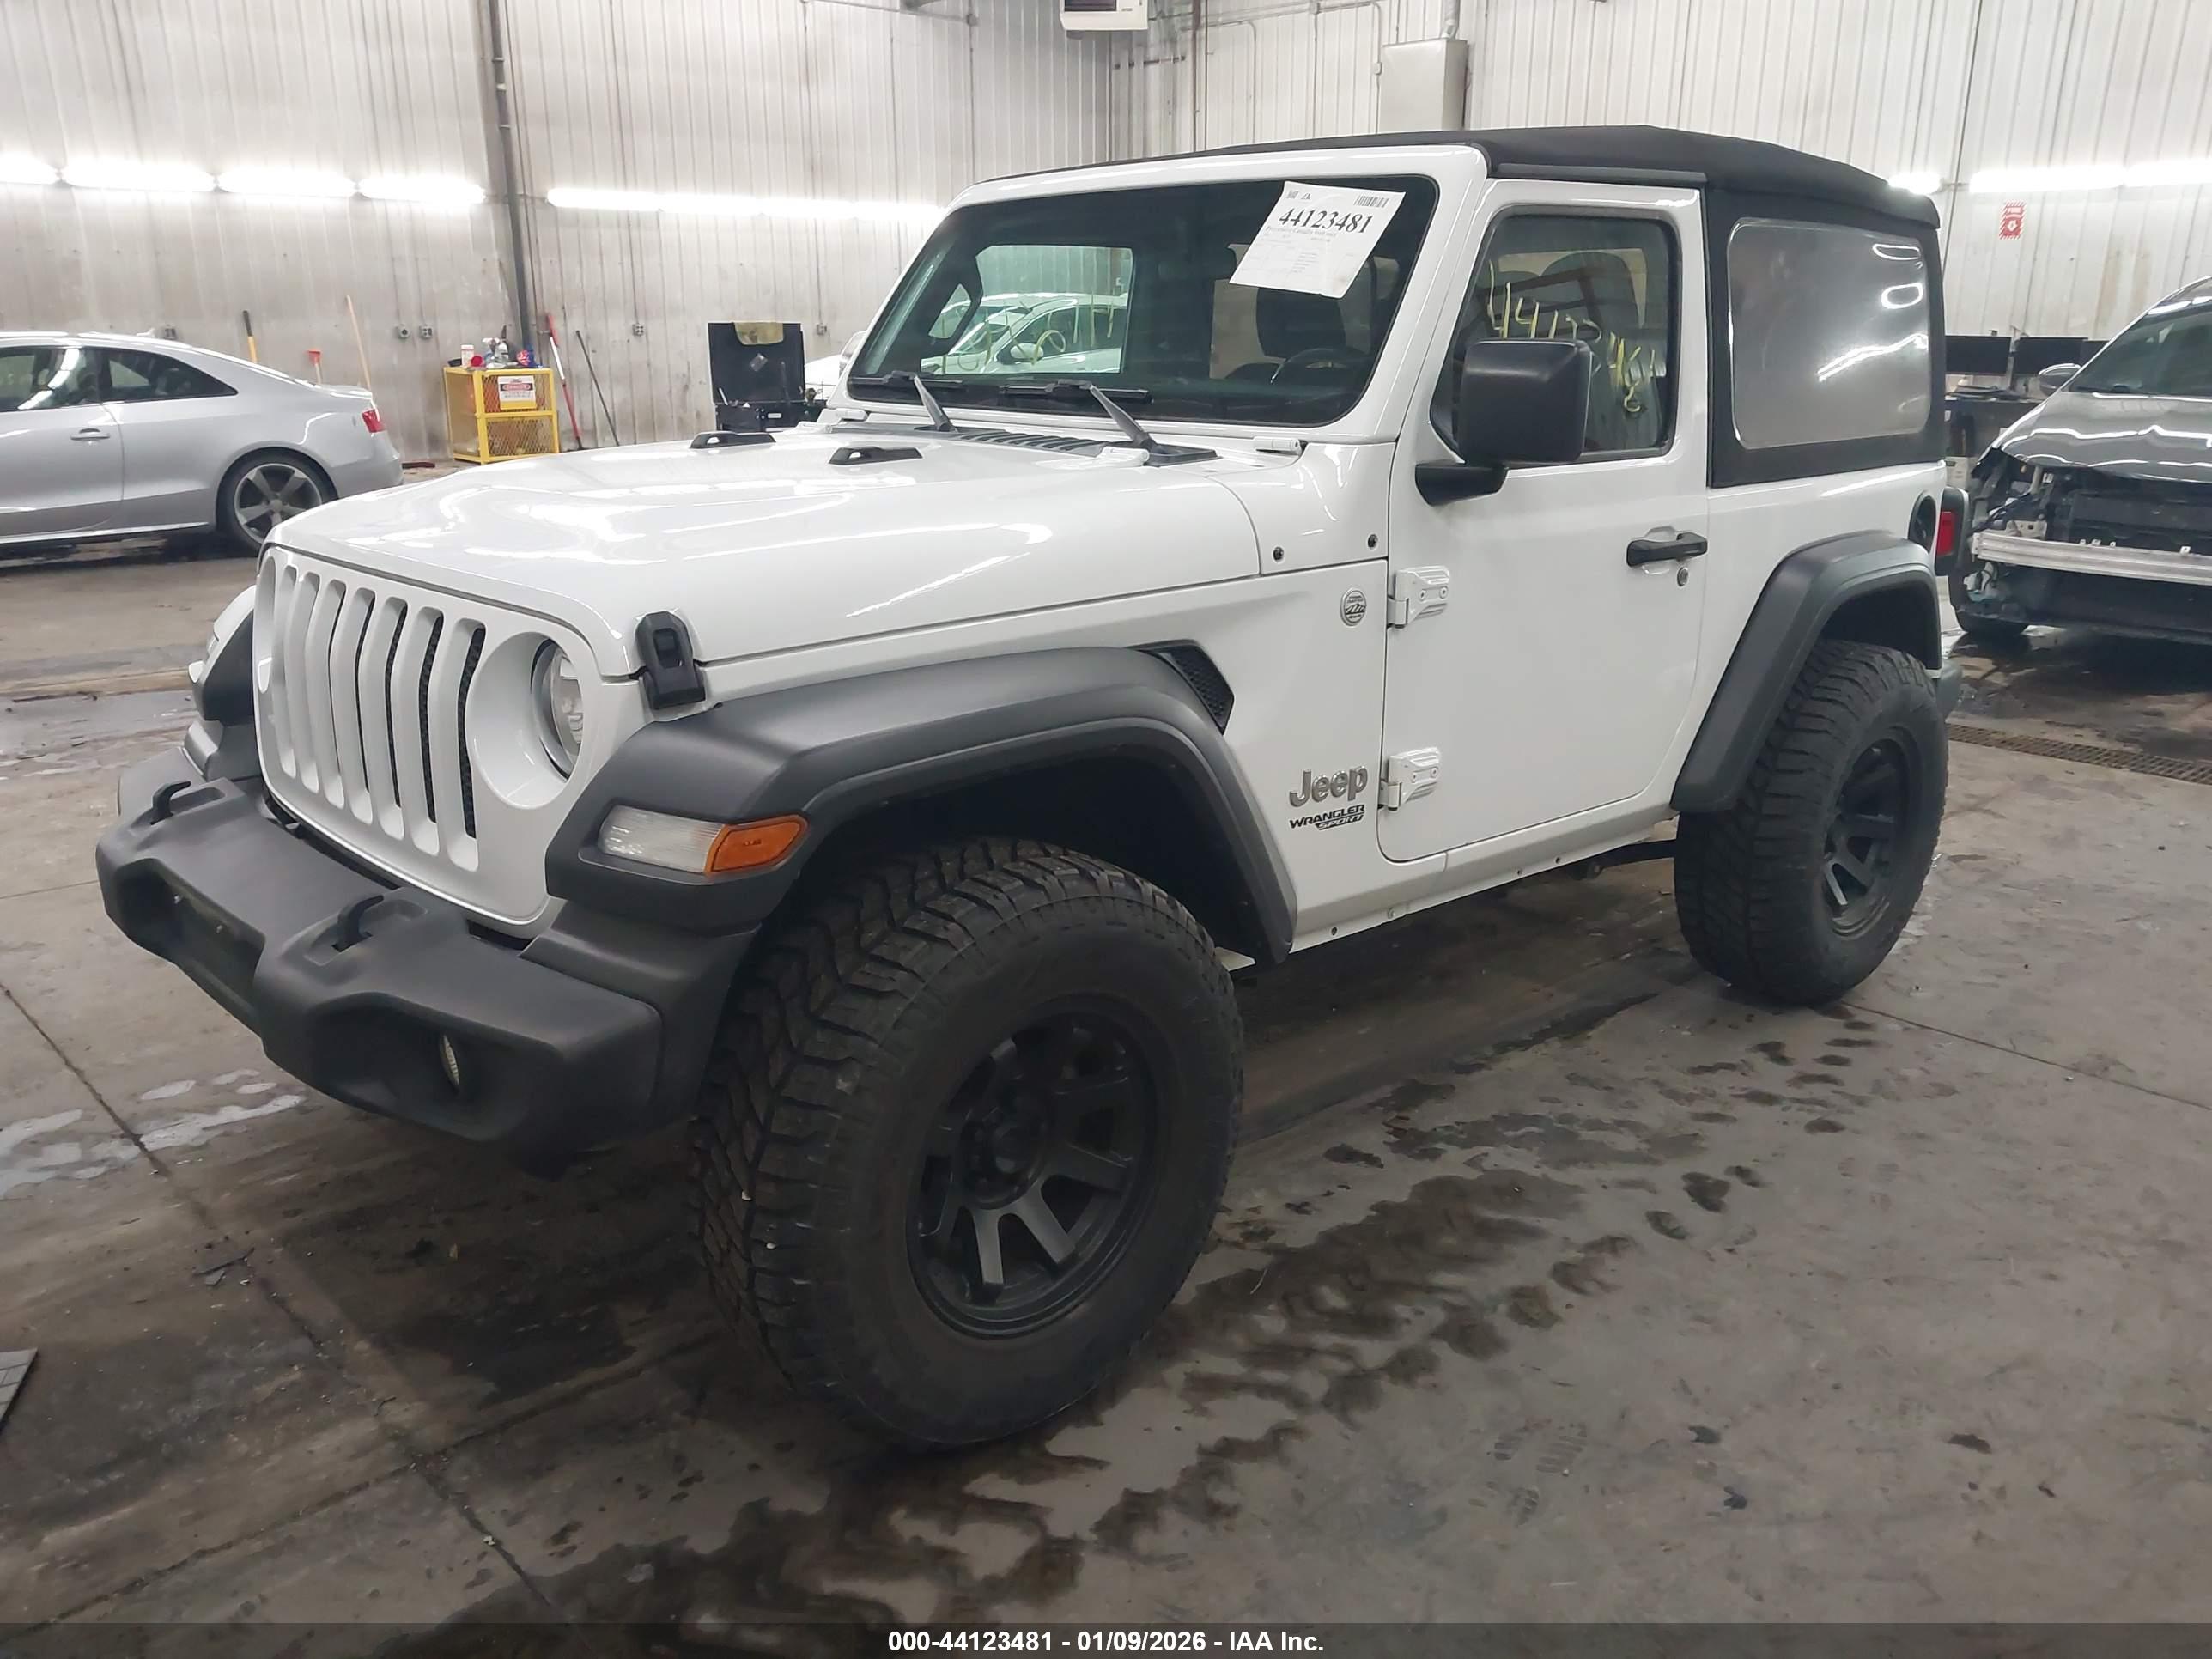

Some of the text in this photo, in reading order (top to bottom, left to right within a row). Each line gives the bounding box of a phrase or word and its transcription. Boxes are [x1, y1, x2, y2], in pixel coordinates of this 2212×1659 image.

[1279, 208, 1373, 233] 44123481
[1289, 766, 1368, 807] Jeep
[1290, 805, 1364, 829] WRANGLER
